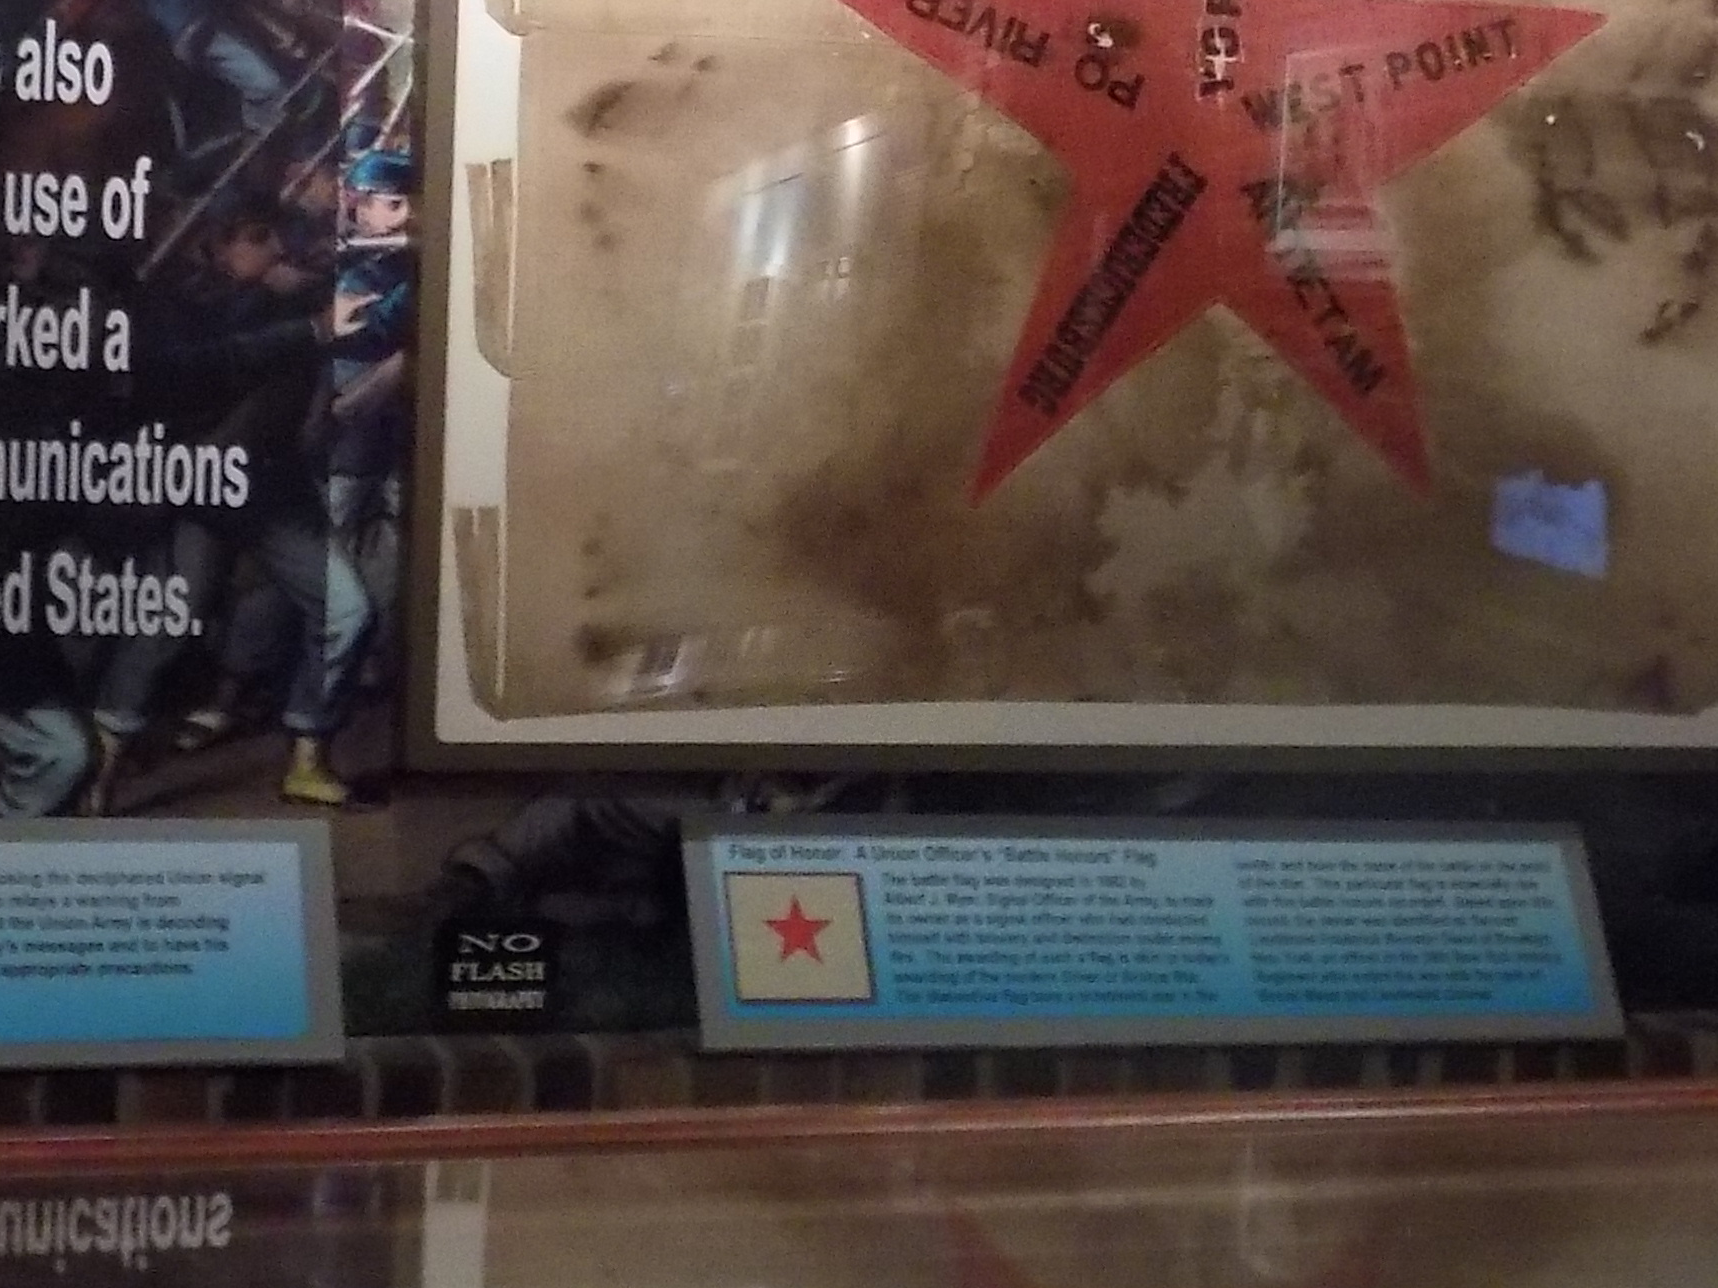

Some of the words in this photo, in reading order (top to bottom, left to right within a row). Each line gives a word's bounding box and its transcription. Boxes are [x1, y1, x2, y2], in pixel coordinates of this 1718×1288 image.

[16, 21, 114, 107] also
[1242, 62, 1371, 131] WEST
[1387, 16, 1522, 94] POINT
[4, 174, 85, 236] use
[101, 156, 150, 242] of
[102, 307, 131, 371] a
[46, 552, 202, 638] States.
[452, 962, 545, 981] FLASH
[459, 934, 541, 953] NO
